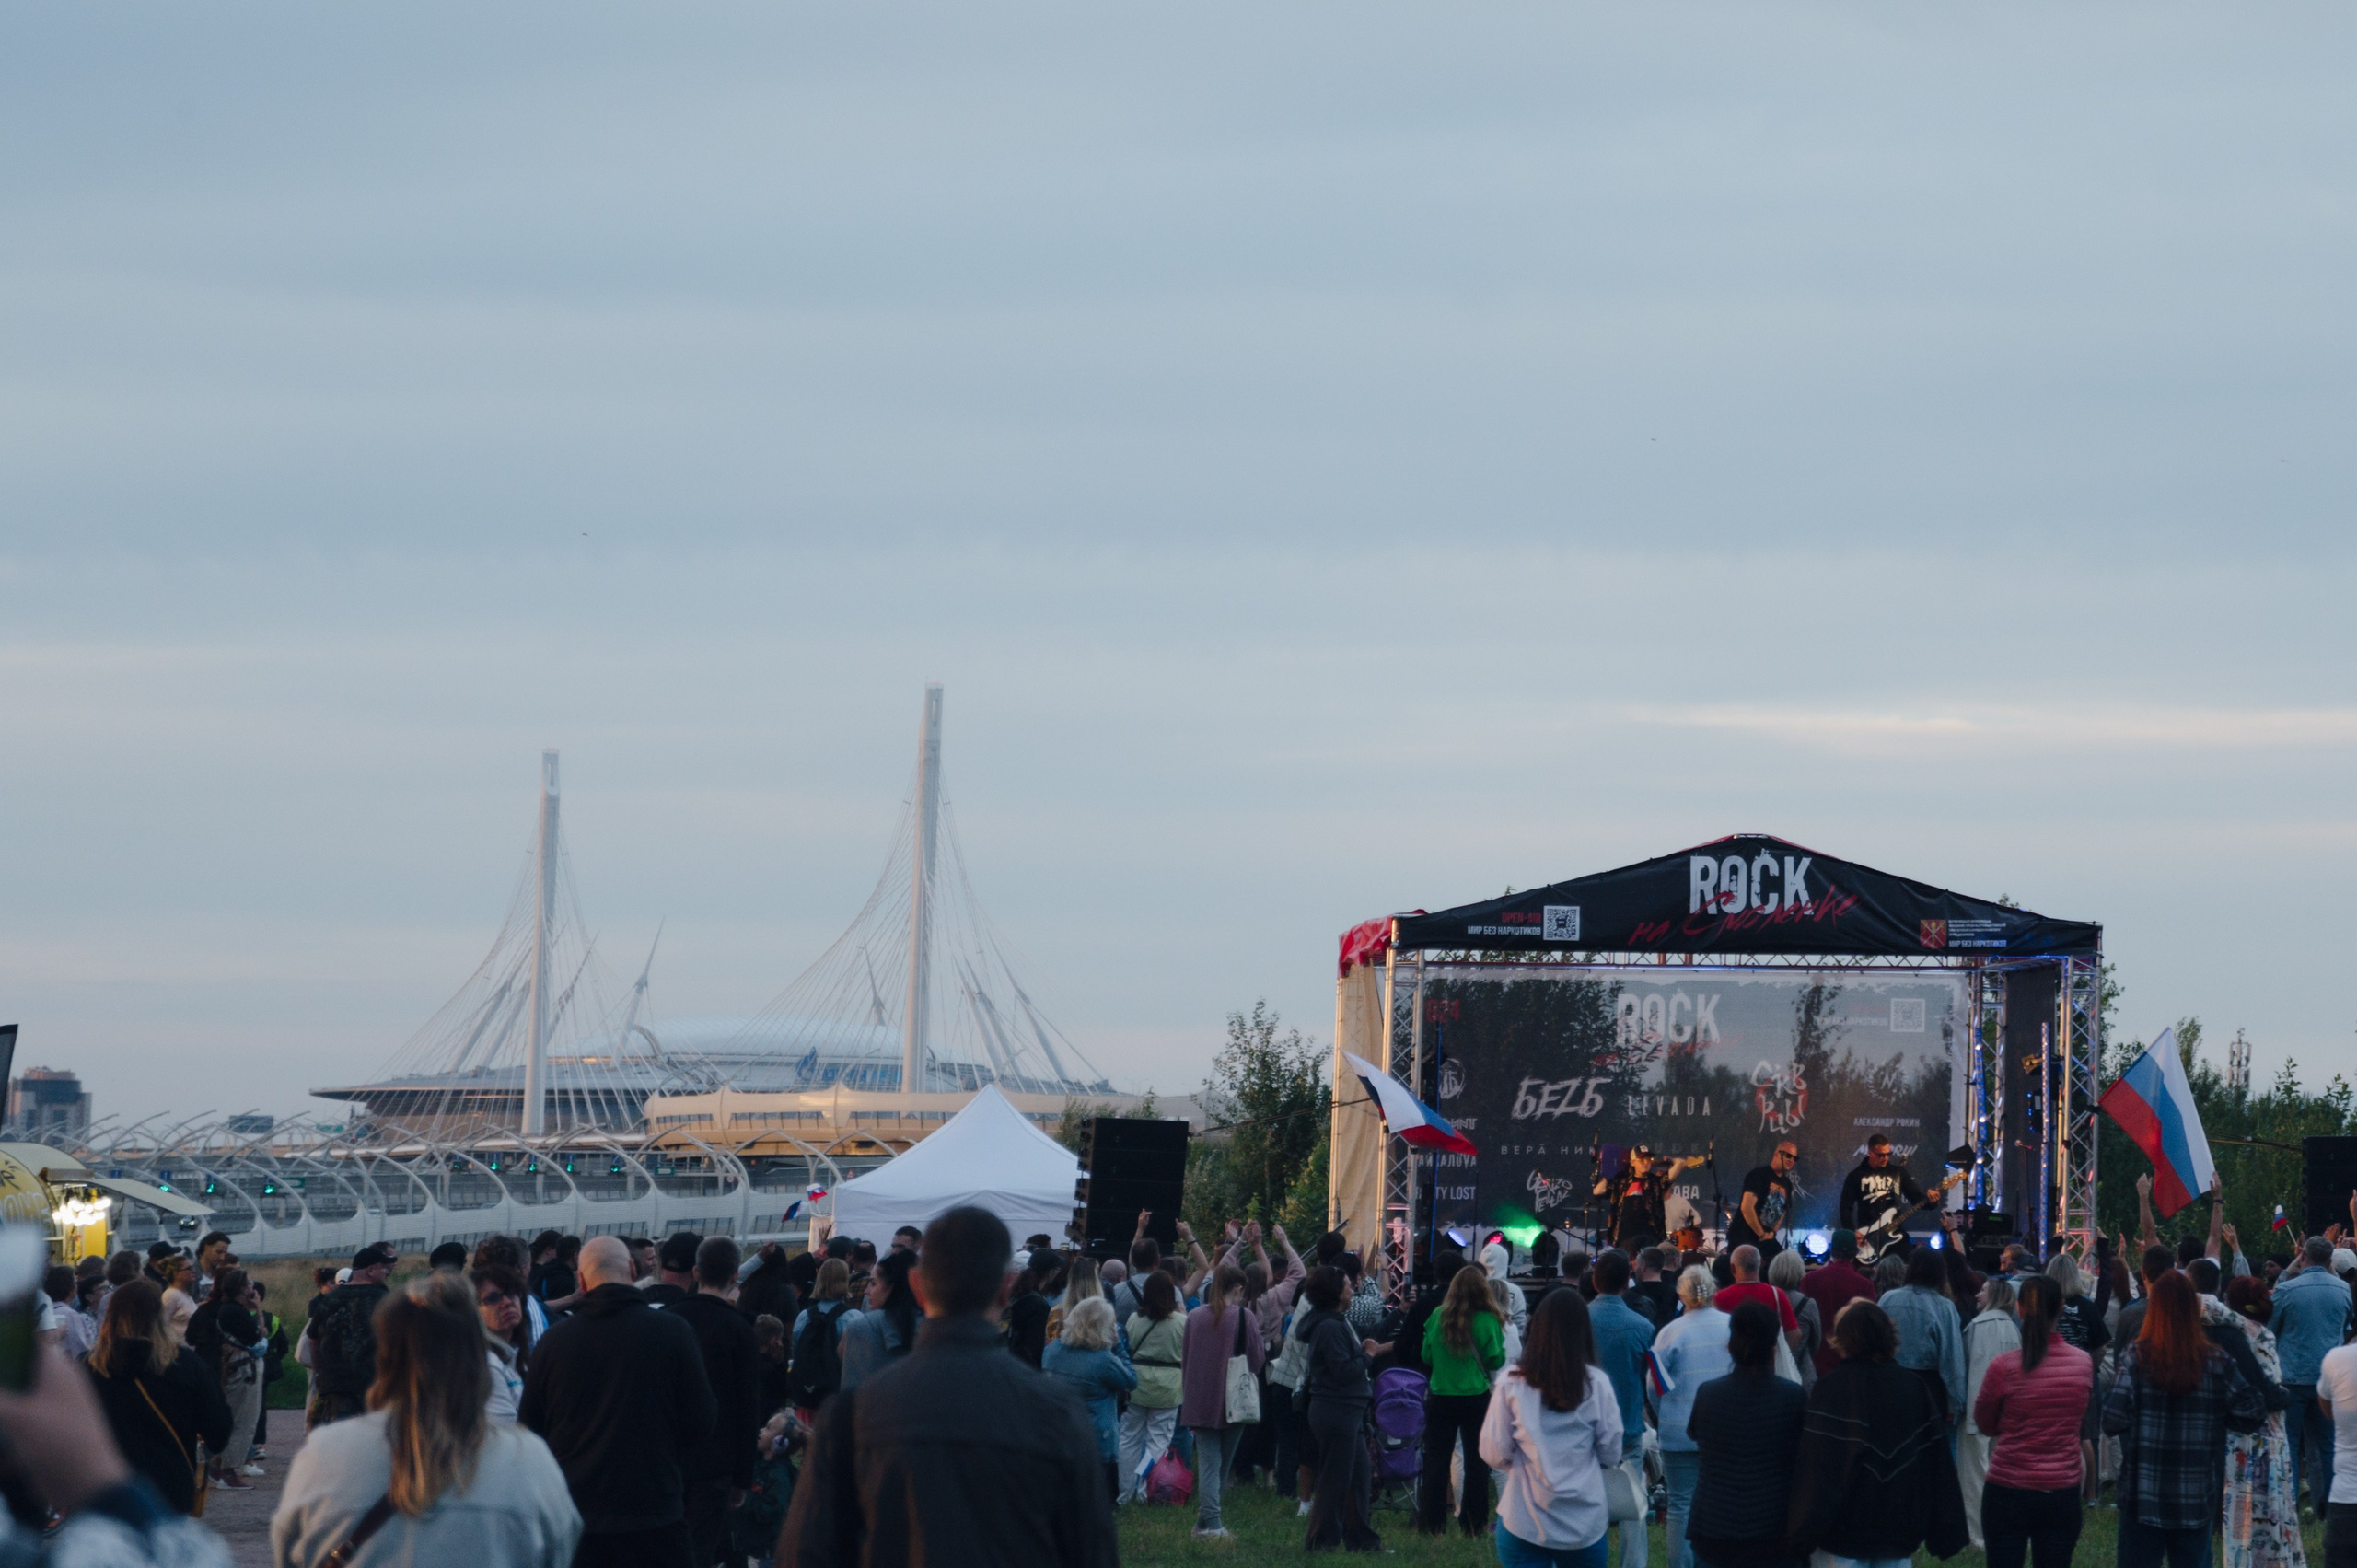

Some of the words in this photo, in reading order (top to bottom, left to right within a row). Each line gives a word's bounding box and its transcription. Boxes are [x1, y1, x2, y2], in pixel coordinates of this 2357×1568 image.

[1689, 848, 1815, 915] ROCK
[1468, 925, 1482, 935] МИР
[1483, 926, 1496, 935] БЕЗ
[1497, 926, 1541, 936] НАРКОТИКОВ
[1424, 999, 1460, 1023] 024
[1616, 988, 1721, 1043] ROCK
[1628, 1095, 1711, 1116] LEVADA
[1853, 1117, 1894, 1128] АЛЕКСАНДР
[1450, 1187, 1476, 1200] LOST
